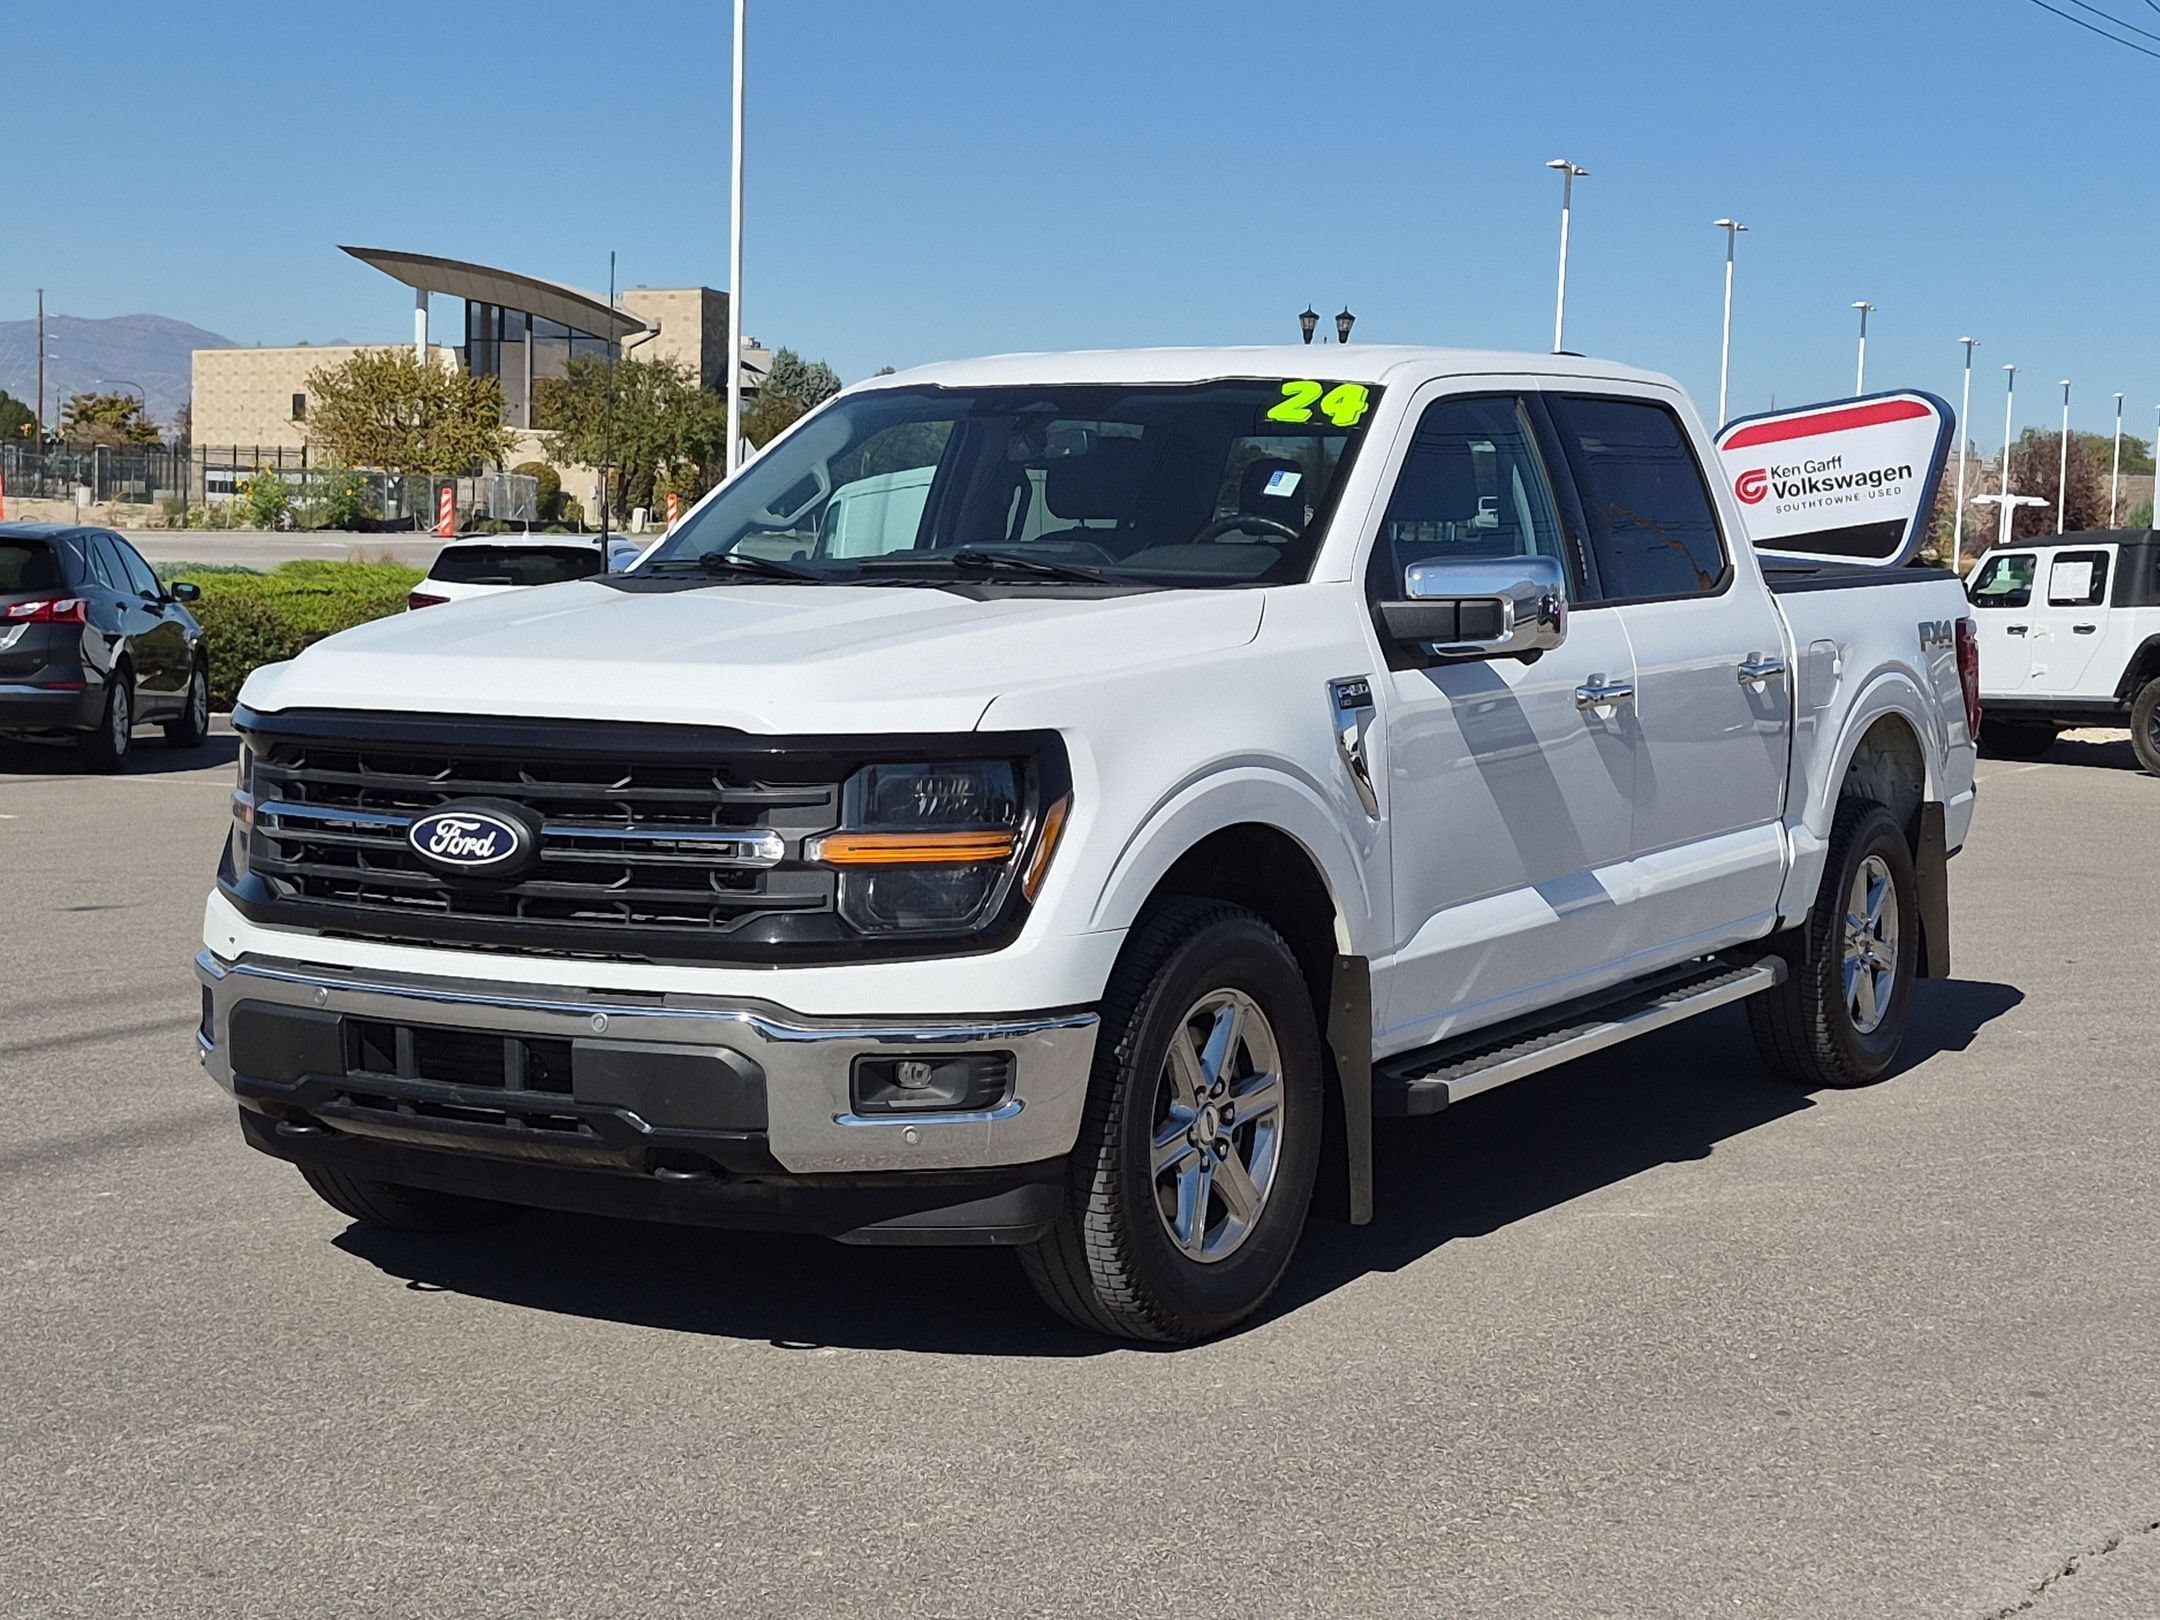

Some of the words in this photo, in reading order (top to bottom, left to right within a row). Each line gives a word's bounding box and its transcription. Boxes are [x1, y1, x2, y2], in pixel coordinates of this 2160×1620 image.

[1267, 381, 1369, 427] 24
[1770, 464, 1800, 479] Ken
[1804, 455, 1842, 475] Garff
[1773, 464, 1913, 499] Volkswagen
[1776, 493, 1861, 514] SOUTHTOWNE
[1868, 486, 1902, 499] USED
[1918, 620, 1953, 652] FX4
[429, 819, 497, 857] Ford
